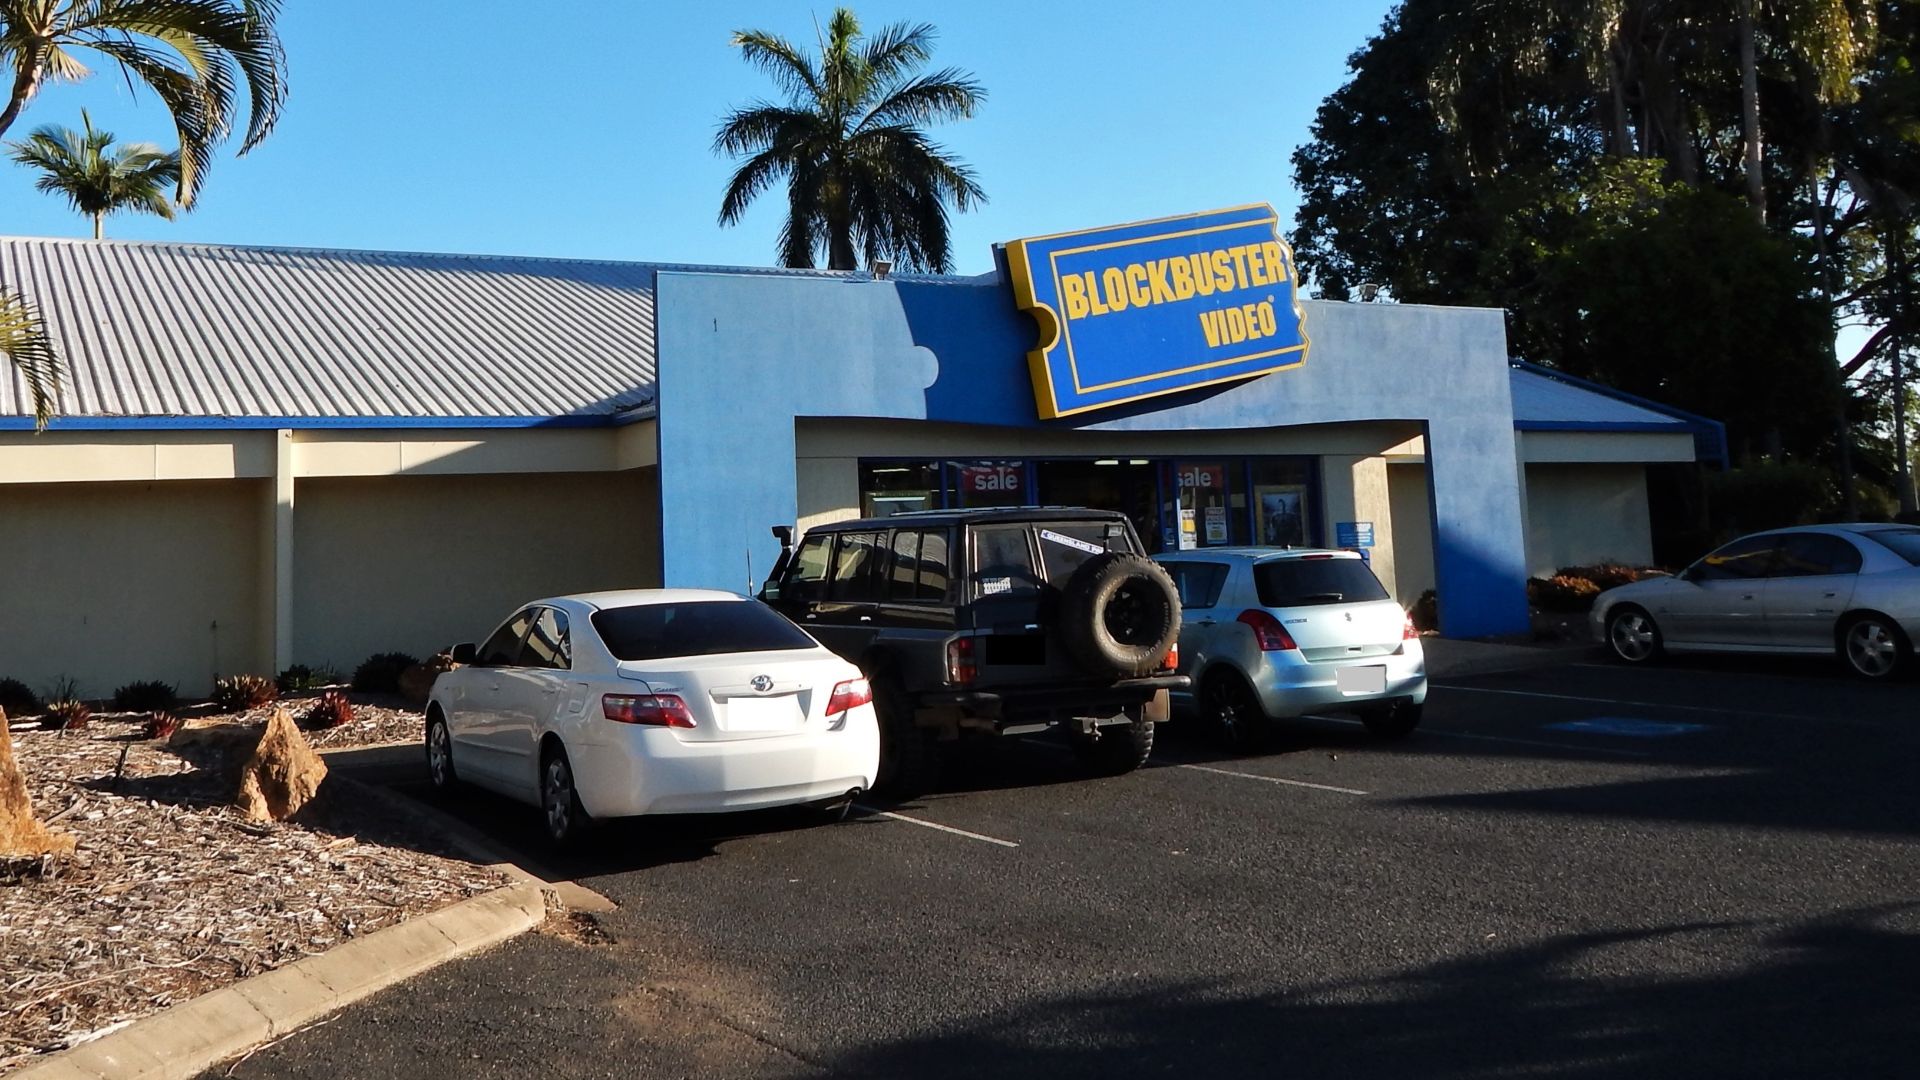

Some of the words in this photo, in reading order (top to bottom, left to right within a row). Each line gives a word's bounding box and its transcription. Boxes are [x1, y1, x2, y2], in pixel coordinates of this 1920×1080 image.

[1061, 241, 1288, 320] BLOCKBUSTER
[1199, 301, 1277, 348] VIDEO
[974, 466, 1018, 490] sale
